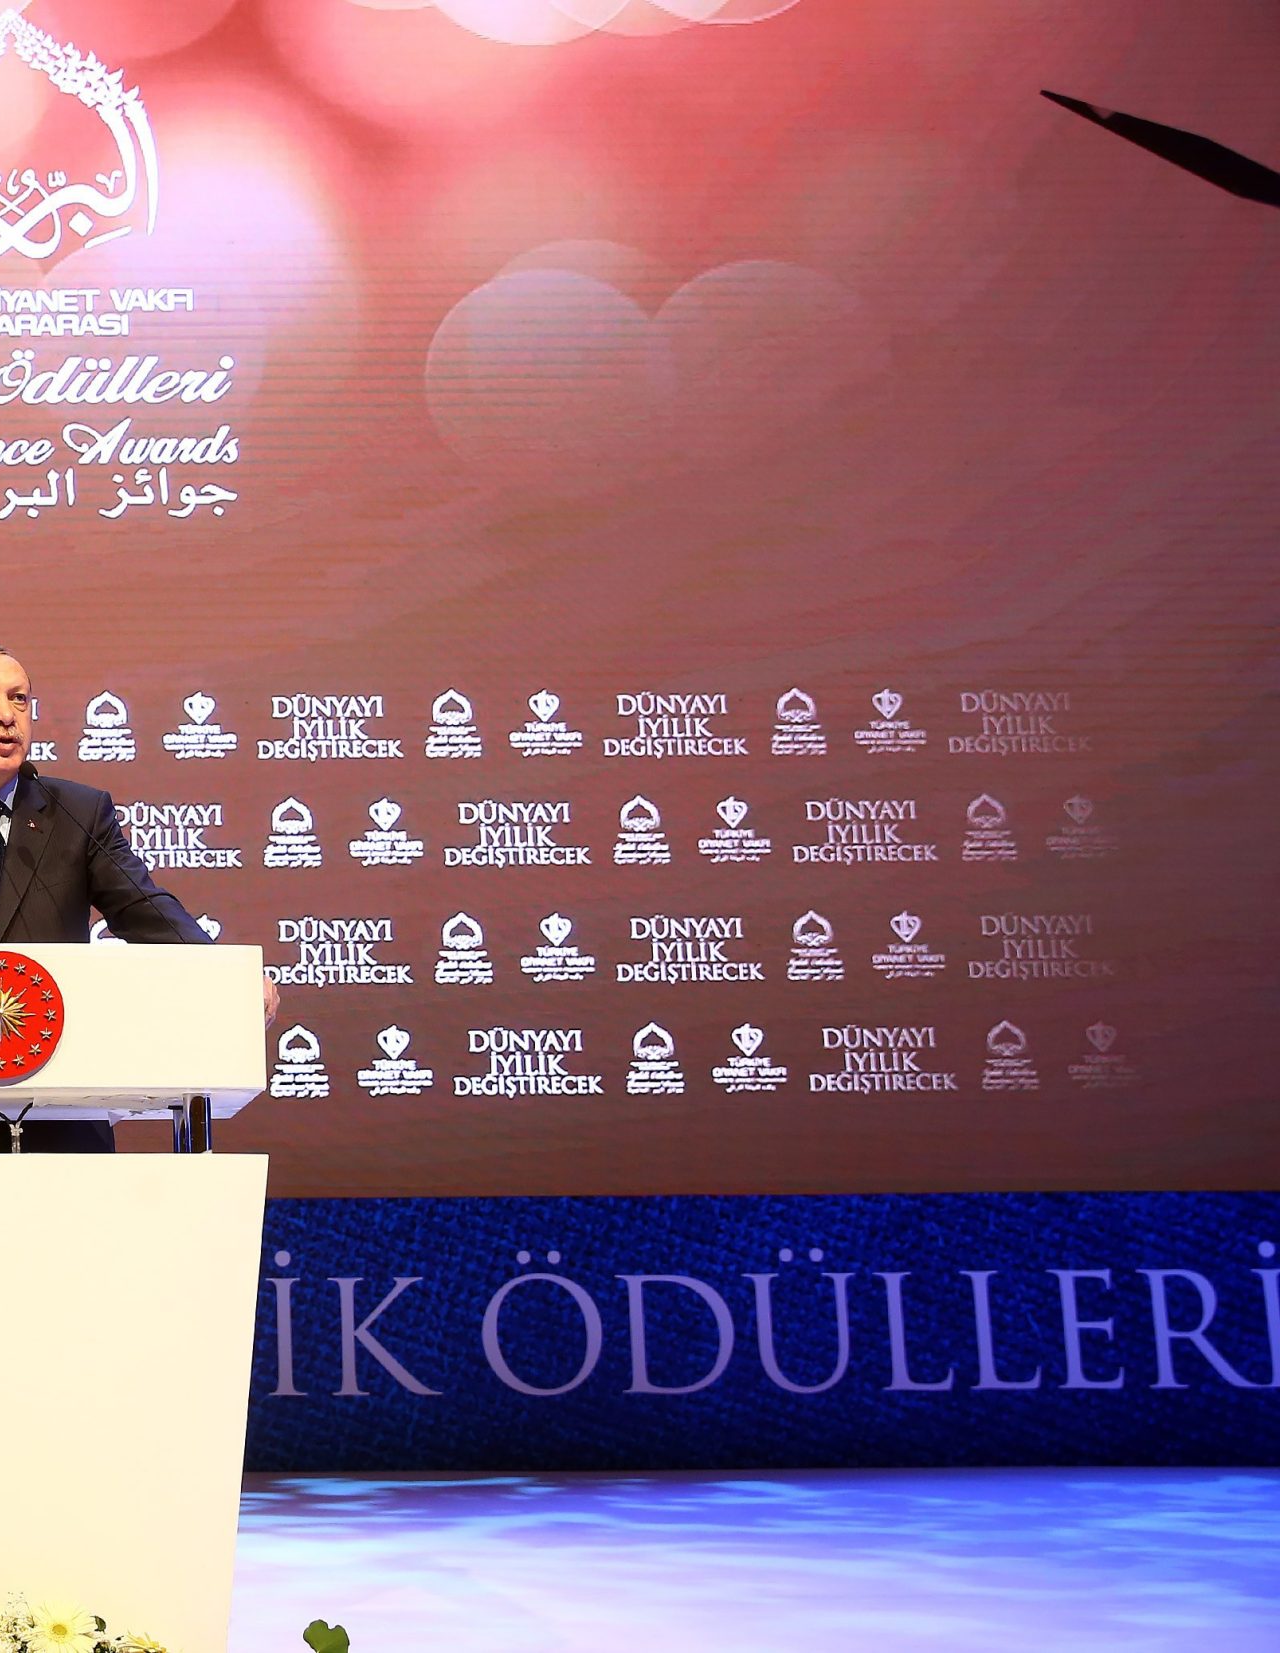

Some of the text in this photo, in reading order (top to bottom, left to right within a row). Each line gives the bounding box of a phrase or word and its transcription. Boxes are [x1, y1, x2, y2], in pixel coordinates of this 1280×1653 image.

[110, 288, 194, 312] VAKFI
[62, 417, 239, 466] Awards
[99, 467, 239, 519] جوائز
[271, 693, 384, 718] DÜNYAYI
[616, 691, 729, 716] DÜNYAYI
[292, 716, 369, 740] İYİLİK
[638, 714, 714, 738] İYİLİK
[457, 799, 572, 825] DÜNYAYI
[804, 797, 918, 822] DÜNYAYI
[129, 825, 207, 849] İYİLİK
[479, 822, 556, 847] İYİLİK
[826, 820, 903, 844] İYİLİK
[278, 916, 393, 942] DÜNYAYI
[629, 914, 744, 940] DÜNYAYI
[300, 940, 377, 965] İYİLİK
[651, 938, 729, 963] İYİLİK
[467, 1026, 584, 1053] DÜNYAYI
[821, 1023, 937, 1050] DÜNYAYI
[490, 1051, 568, 1076] İYİLİK
[844, 1048, 922, 1073] İYİLİK
[481, 1241, 1280, 1397] ÖDÜLLERİ
